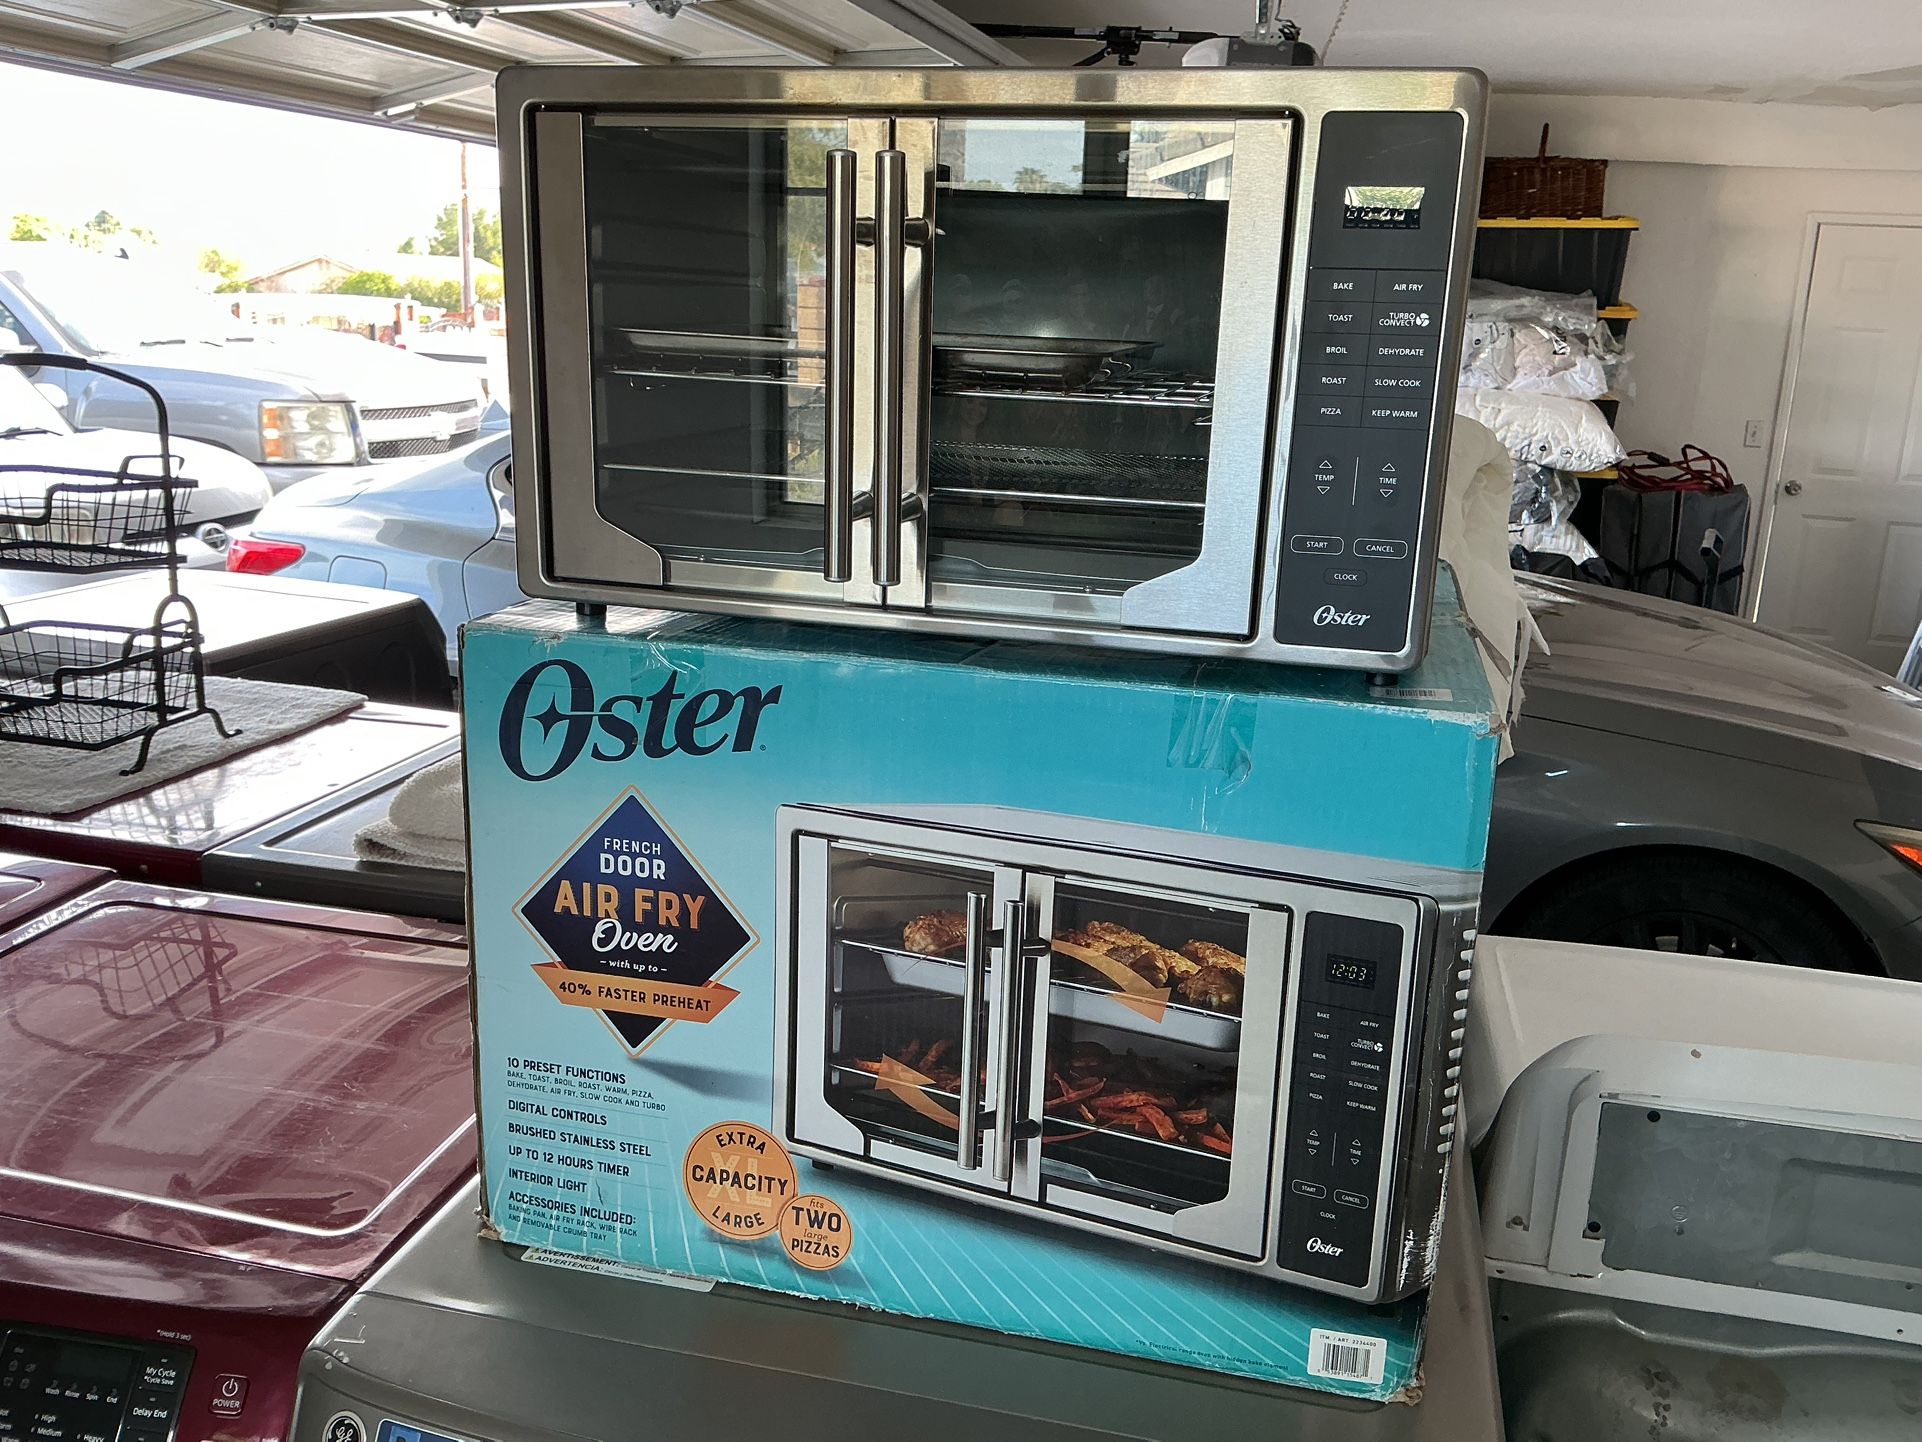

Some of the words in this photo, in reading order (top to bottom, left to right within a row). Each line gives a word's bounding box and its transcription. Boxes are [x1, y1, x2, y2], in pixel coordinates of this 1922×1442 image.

[1333, 282, 1354, 290] BAKE
[1393, 283, 1407, 291] AIR
[1408, 284, 1423, 292] FRY
[1328, 314, 1353, 322] TOAST
[1389, 312, 1416, 320] TURBO
[1379, 319, 1415, 327] CONVECT
[1326, 346, 1348, 354] BROIL
[1378, 348, 1424, 357] DEHYDRATE
[1321, 376, 1347, 385] ROAST
[1374, 378, 1398, 387] SLOW
[1398, 379, 1422, 388] COOK
[1320, 407, 1342, 415] PIZZA
[1371, 409, 1391, 417] KEEP
[1392, 410, 1418, 418] WARM
[1314, 474, 1335, 482] TEMP
[1379, 477, 1398, 485] TIME
[1306, 541, 1328, 549] START
[1366, 544, 1395, 553] CANCEL
[1333, 573, 1358, 581] CLOCK
[1313, 604, 1371, 627] Oster
[498, 658, 783, 782] Oster
[603, 837, 661, 856] FRENCH
[600, 853, 666, 881] DOOR
[553, 879, 620, 919] AIR
[634, 889, 707, 930] FRY
[591, 917, 679, 954] Oven
[608, 958, 630, 970] with
[632, 962, 646, 974] up
[647, 962, 659, 973] to
[1331, 963, 1367, 981] 12:03
[558, 980, 592, 997] 40%
[597, 985, 647, 1005] FASTER
[652, 993, 711, 1013] PREHEAT
[1316, 1011, 1330, 1019] BAKE
[1313, 1032, 1330, 1040] TOAST
[1350, 1042, 1374, 1051] CONVECT
[1357, 1038, 1375, 1046] TURBO
[1312, 1052, 1327, 1060] BROIL
[507, 1056, 520, 1069] 10
[523, 1059, 562, 1075] PRESET
[565, 1066, 626, 1085] FUNCTIONS
[1350, 1060, 1380, 1071] DEHYDRATE
[1309, 1072, 1327, 1080] ROAST
[528, 1073, 552, 1084] TOAST,
[554, 1077, 576, 1088] BROIL,
[578, 1081, 602, 1092] ROAST,
[604, 1085, 629, 1096] WARM,
[631, 1089, 654, 1100] PIZZA,
[1348, 1080, 1363, 1089] SLOW
[1363, 1083, 1379, 1092] COOK
[507, 1080, 548, 1094] DEHYDRATE,
[550, 1087, 562, 1095] AIR
[563, 1089, 578, 1098] FRY,
[580, 1091, 600, 1101] SLOW
[603, 1095, 623, 1105] COOK
[625, 1099, 640, 1108] AND
[642, 1101, 666, 1112] TURBO
[508, 1099, 548, 1117] DIGITAL
[551, 1107, 608, 1126] CONTROLS
[508, 1122, 556, 1141] BRUSHED
[559, 1131, 616, 1151] STAINLESS
[619, 1141, 652, 1157] STEEL
[715, 1131, 767, 1155] EXTRA
[1306, 1138, 1320, 1146] TEMP
[508, 1145, 523, 1157] UP
[525, 1148, 539, 1161] TO
[542, 1151, 554, 1163] 12
[557, 1155, 594, 1171] HOURS
[597, 1161, 630, 1177] TIMER
[508, 1167, 553, 1187] INTERIOR
[557, 1177, 588, 1193] LIGHT
[691, 1164, 789, 1196] CAPACITY
[809, 1198, 825, 1209] fits
[1341, 1194, 1361, 1204] CANCEL
[508, 1190, 577, 1215] ACCESSORIES
[580, 1205, 637, 1226] INCLUDED:
[508, 1203, 531, 1216] BAKING
[533, 1210, 548, 1220] PAN,
[549, 1213, 560, 1222] AIR
[562, 1216, 575, 1225] FRY
[576, 1218, 597, 1230] RACK,
[599, 1223, 616, 1233] WIRE
[618, 1227, 638, 1237] RACK
[712, 1205, 765, 1229] LARGE
[791, 1206, 842, 1233] TWO
[508, 1214, 520, 1223] AND
[523, 1217, 561, 1232] REMOVABLE
[563, 1226, 588, 1238] CRUMB
[589, 1231, 607, 1241] TRAY
[803, 1229, 829, 1243] large
[791, 1238, 840, 1259] PIZZAS
[1306, 1236, 1344, 1257] Oster
[535, 1255, 604, 1272] ADVERTENCIA:
[1212, 1352, 1226, 1360] with
[145, 1366, 157, 1375] My
[157, 1368, 177, 1378] Cycle
[161, 1378, 174, 1386] Save
[85, 1393, 99, 1401] Spin
[106, 1396, 118, 1404] End
[212, 1398, 240, 1409] POWER
[132, 1407, 153, 1418] Delay
[153, 1409, 168, 1419] End
[40, 1414, 57, 1424] High
[36, 1427, 63, 1437] Medium
